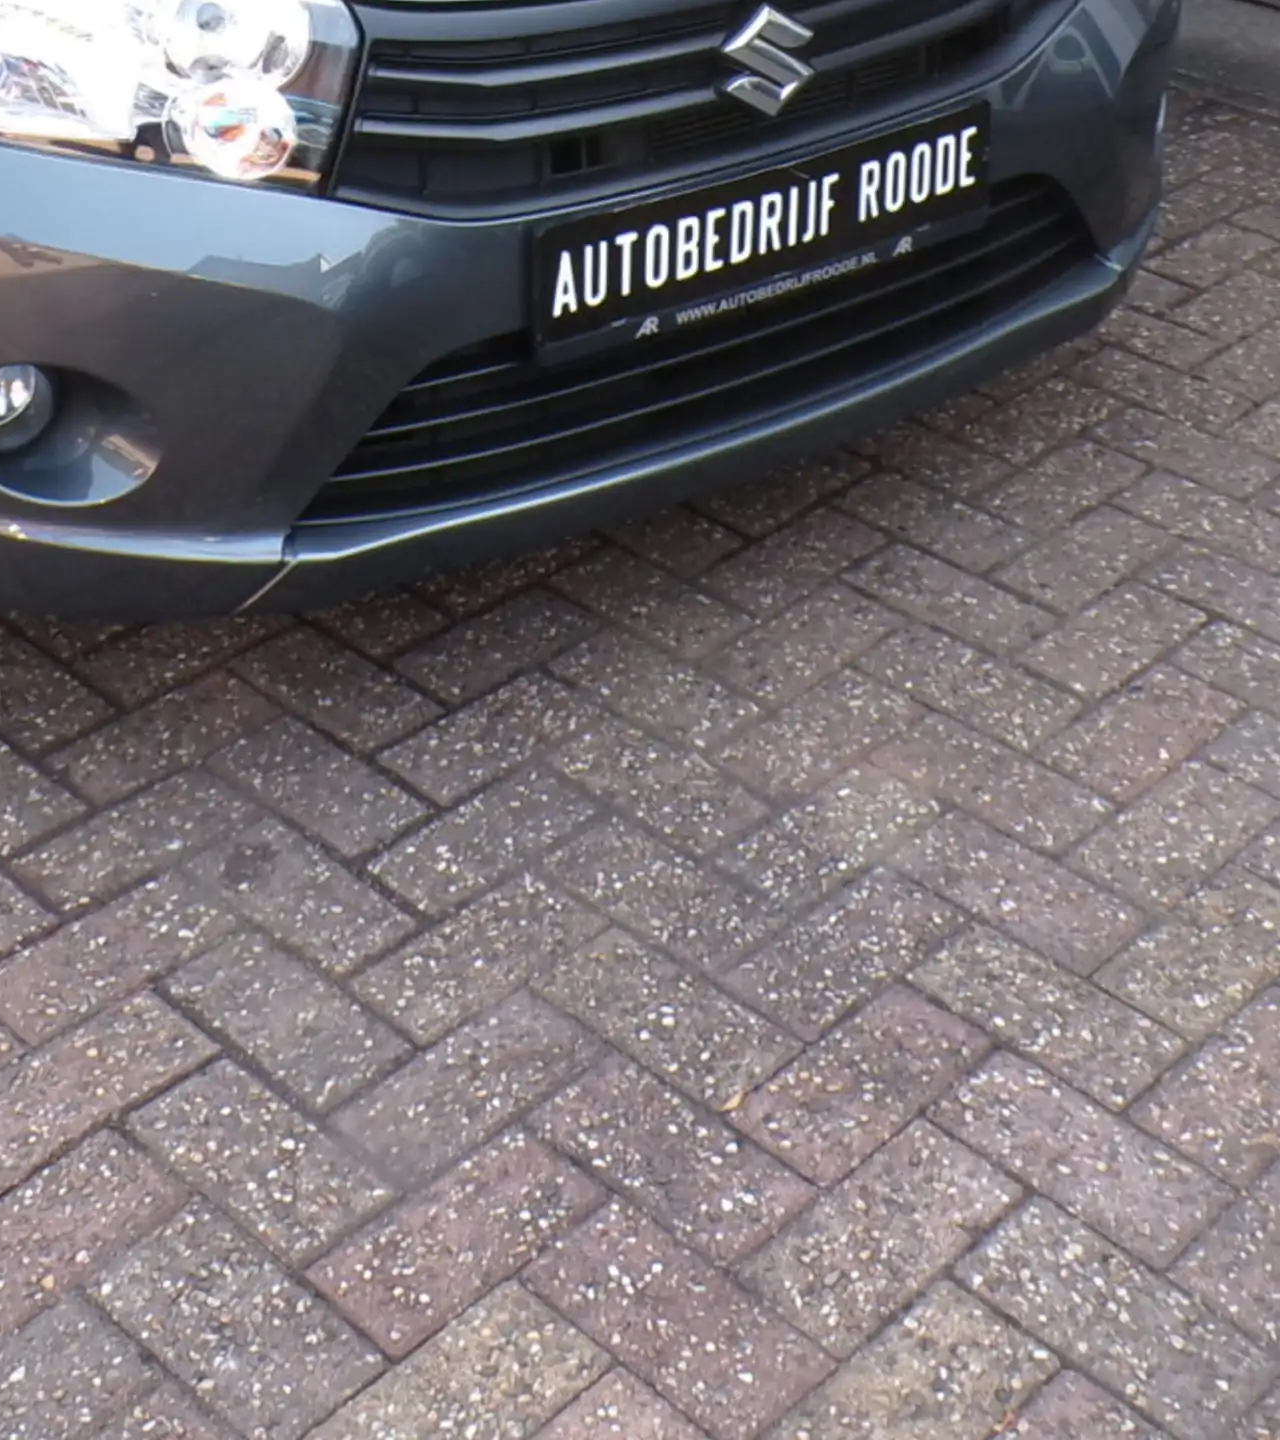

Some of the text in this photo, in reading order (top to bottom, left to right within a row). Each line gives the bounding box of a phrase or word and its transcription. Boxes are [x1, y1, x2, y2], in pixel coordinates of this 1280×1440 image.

[551, 125, 979, 319] AUTOBEDRIJF ROODE
[674, 250, 880, 327] WWW.AUTOBEDRIJFROODE.NL
